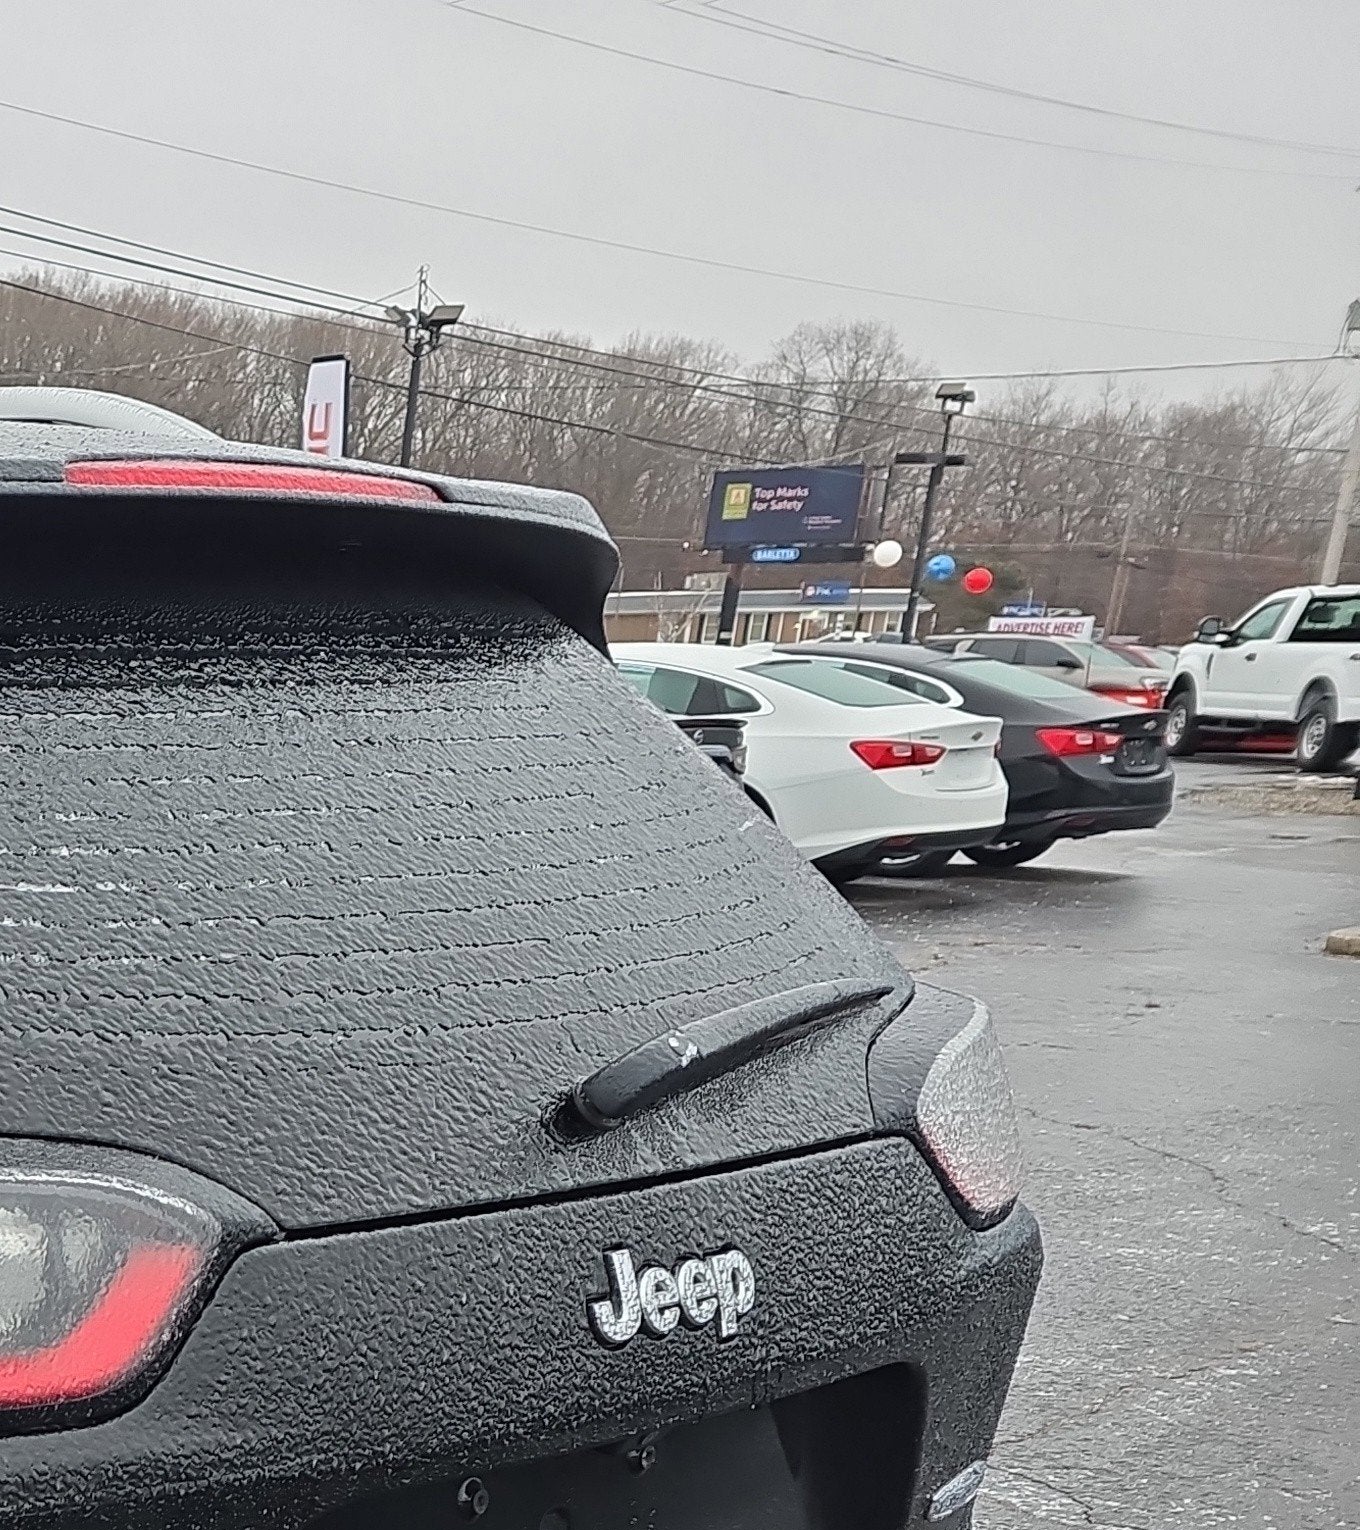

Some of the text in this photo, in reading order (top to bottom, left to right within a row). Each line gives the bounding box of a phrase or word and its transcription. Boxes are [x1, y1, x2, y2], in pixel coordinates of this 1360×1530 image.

[308, 402, 333, 455] U
[754, 486, 809, 500] Top Marks
[770, 499, 804, 512] Safety
[996, 622, 1051, 634] ADVERTISE
[590, 1247, 755, 1343] Jeep
